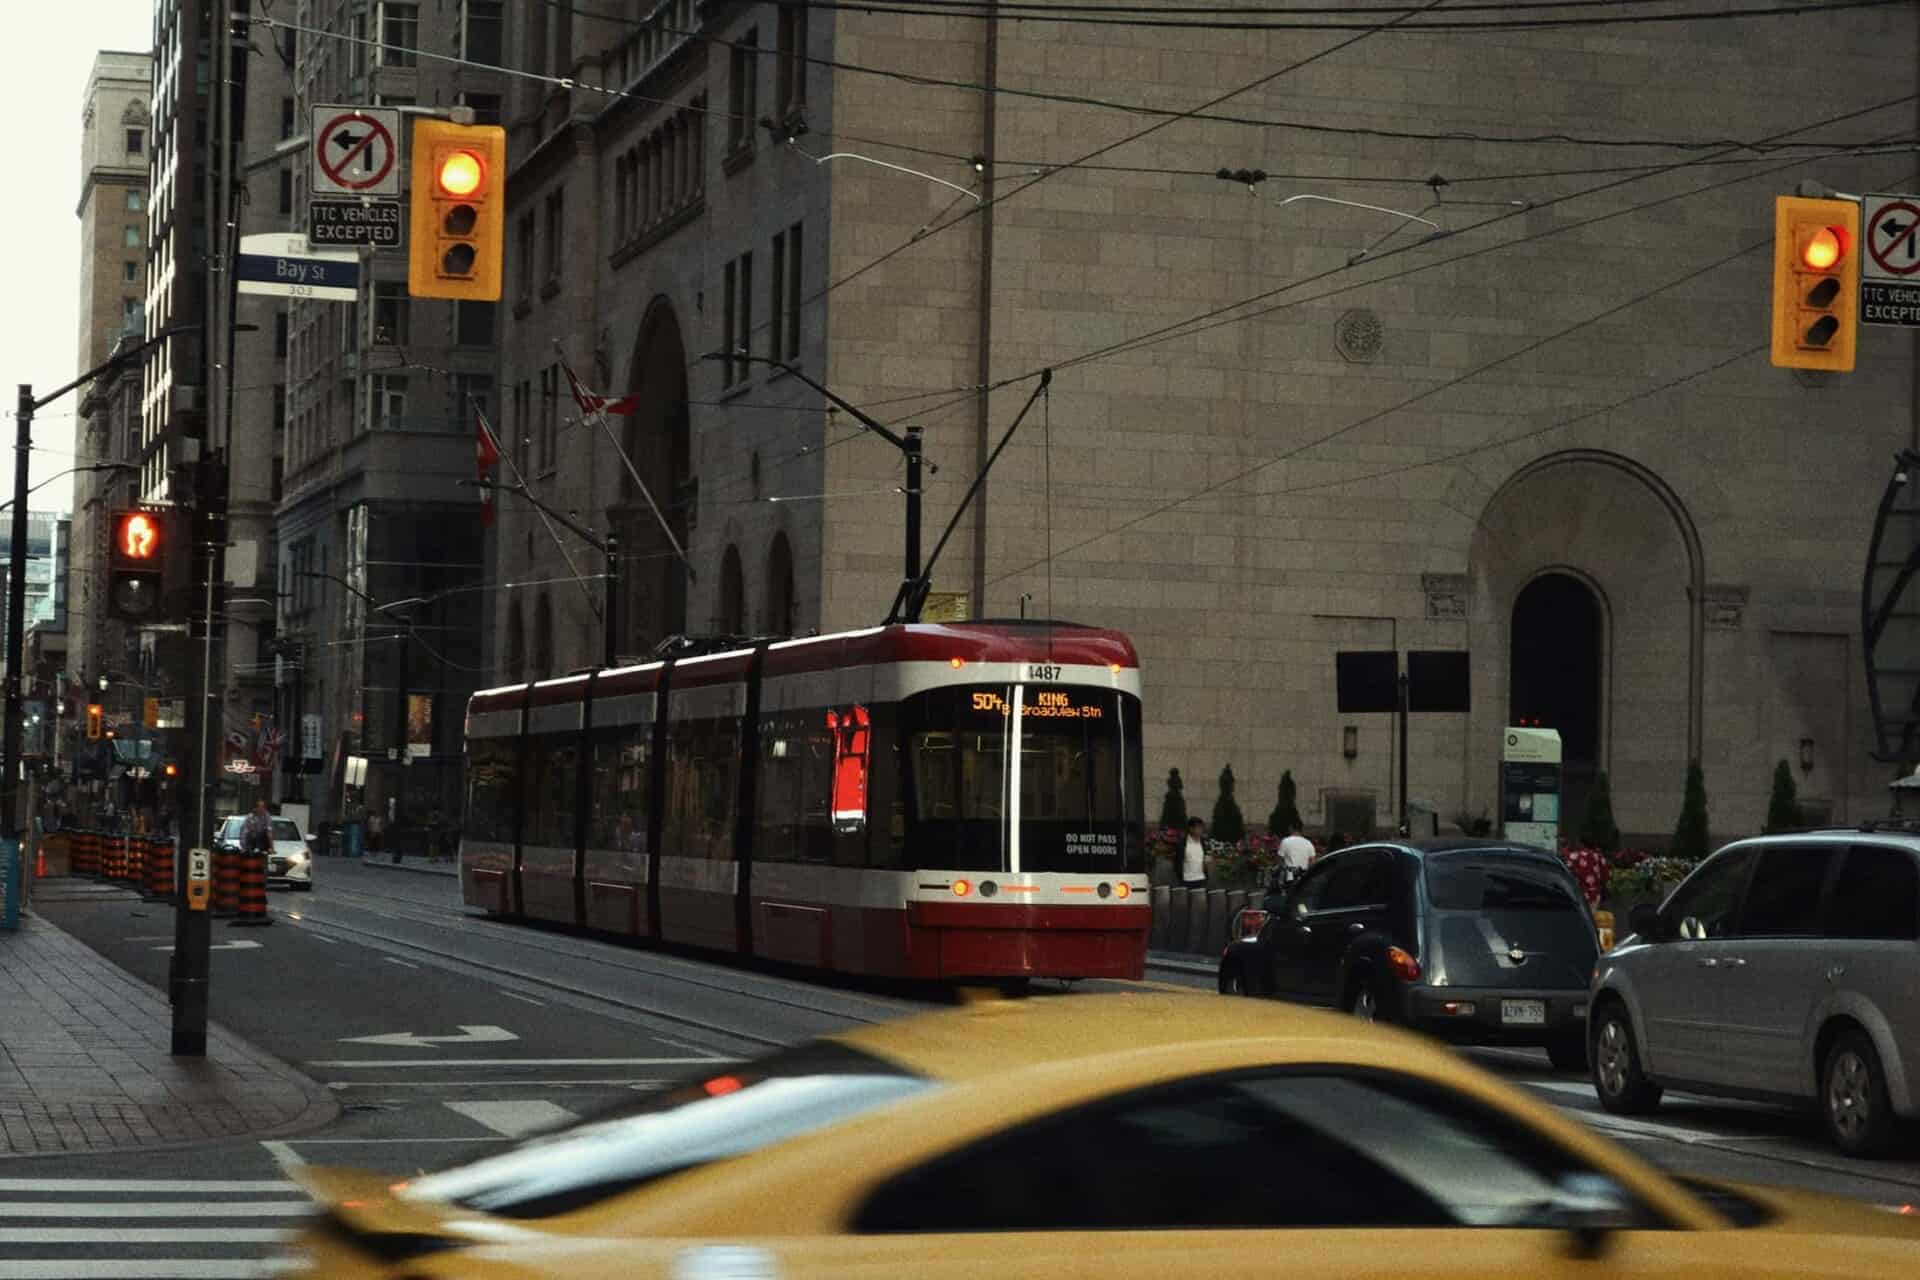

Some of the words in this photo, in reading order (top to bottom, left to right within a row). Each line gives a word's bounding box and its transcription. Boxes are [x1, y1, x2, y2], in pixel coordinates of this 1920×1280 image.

[312, 206, 336, 220] TTC
[341, 207, 398, 222] VEHICLES
[315, 224, 394, 240] EXCEPTED
[276, 259, 306, 282] Bay
[311, 265, 325, 280] St
[1863, 287, 1885, 301] TTC
[1039, 692, 1069, 706] KING
[1081, 706, 1102, 718] Stn
[1065, 833, 1078, 843] DO
[1080, 834, 1096, 843] NOT
[1066, 844, 1089, 855] OPEN
